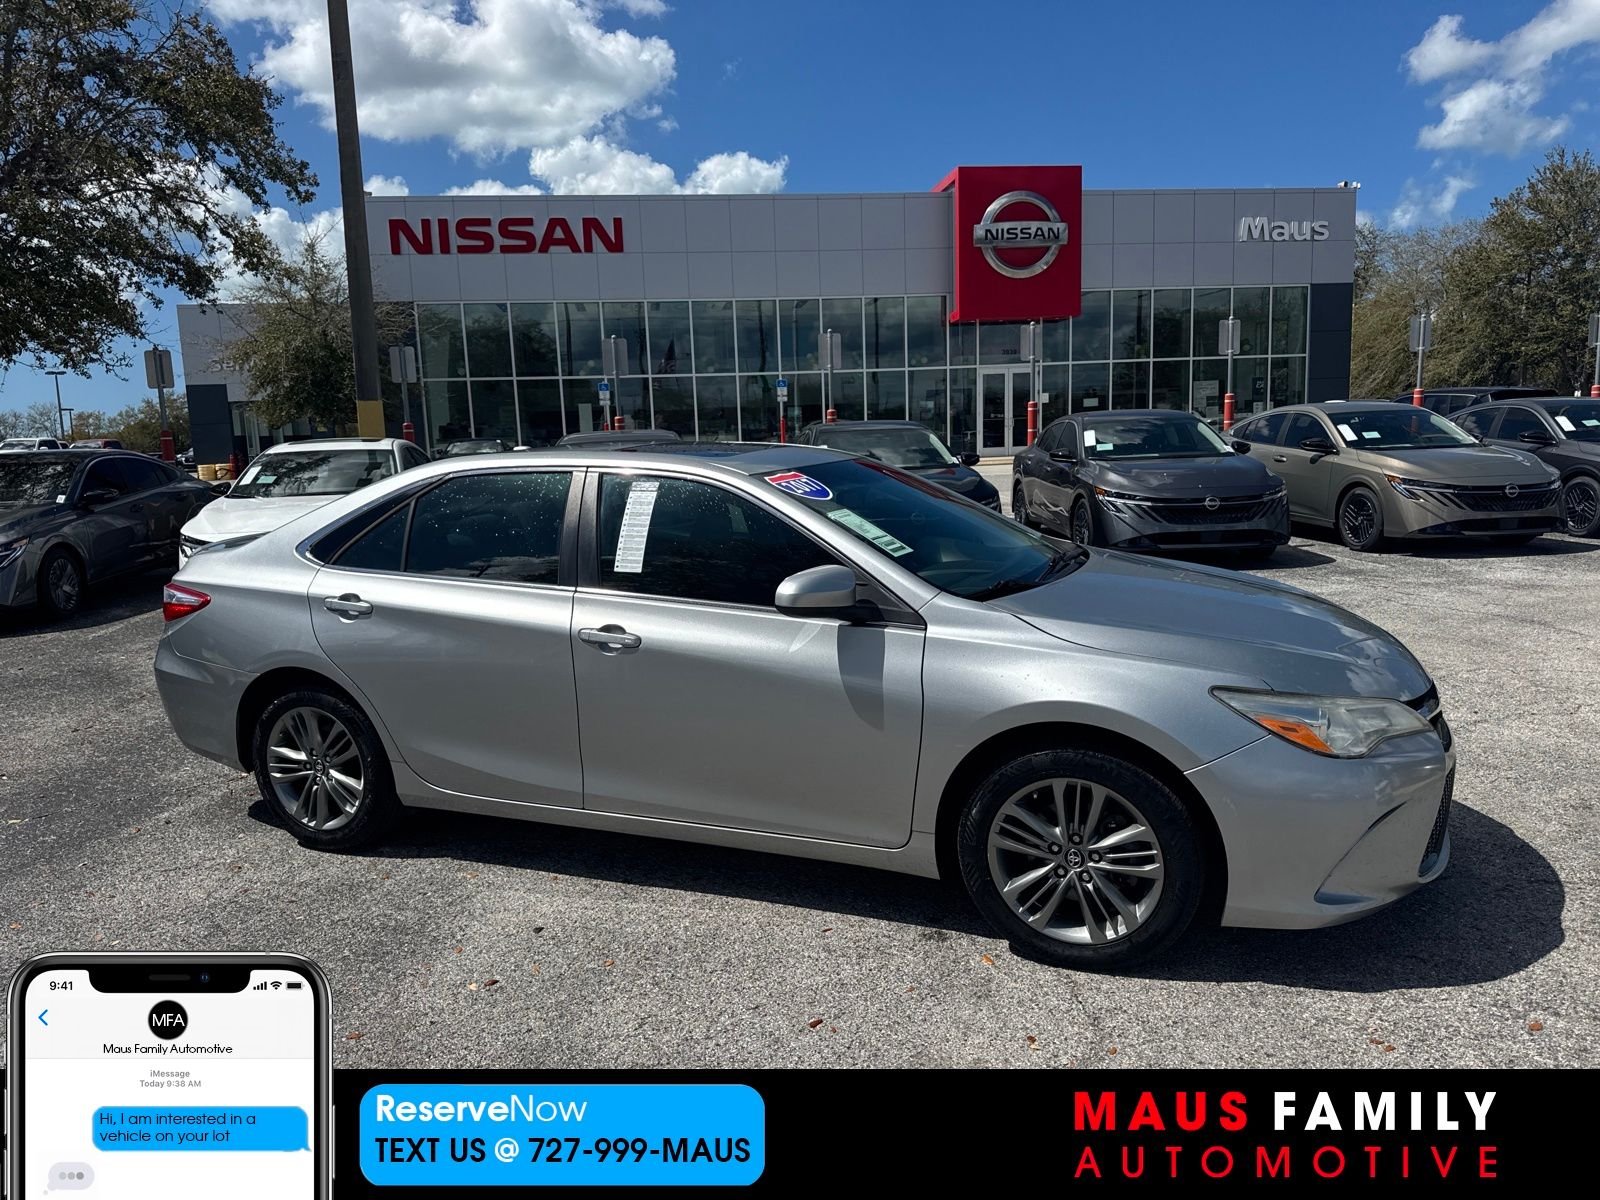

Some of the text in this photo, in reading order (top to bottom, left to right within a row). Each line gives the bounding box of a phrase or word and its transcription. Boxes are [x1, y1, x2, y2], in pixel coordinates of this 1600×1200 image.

[388, 217, 624, 255] NISSAN
[984, 226, 1060, 241] NISSAN
[1239, 216, 1330, 242] Maus
[780, 478, 822, 493] 2017
